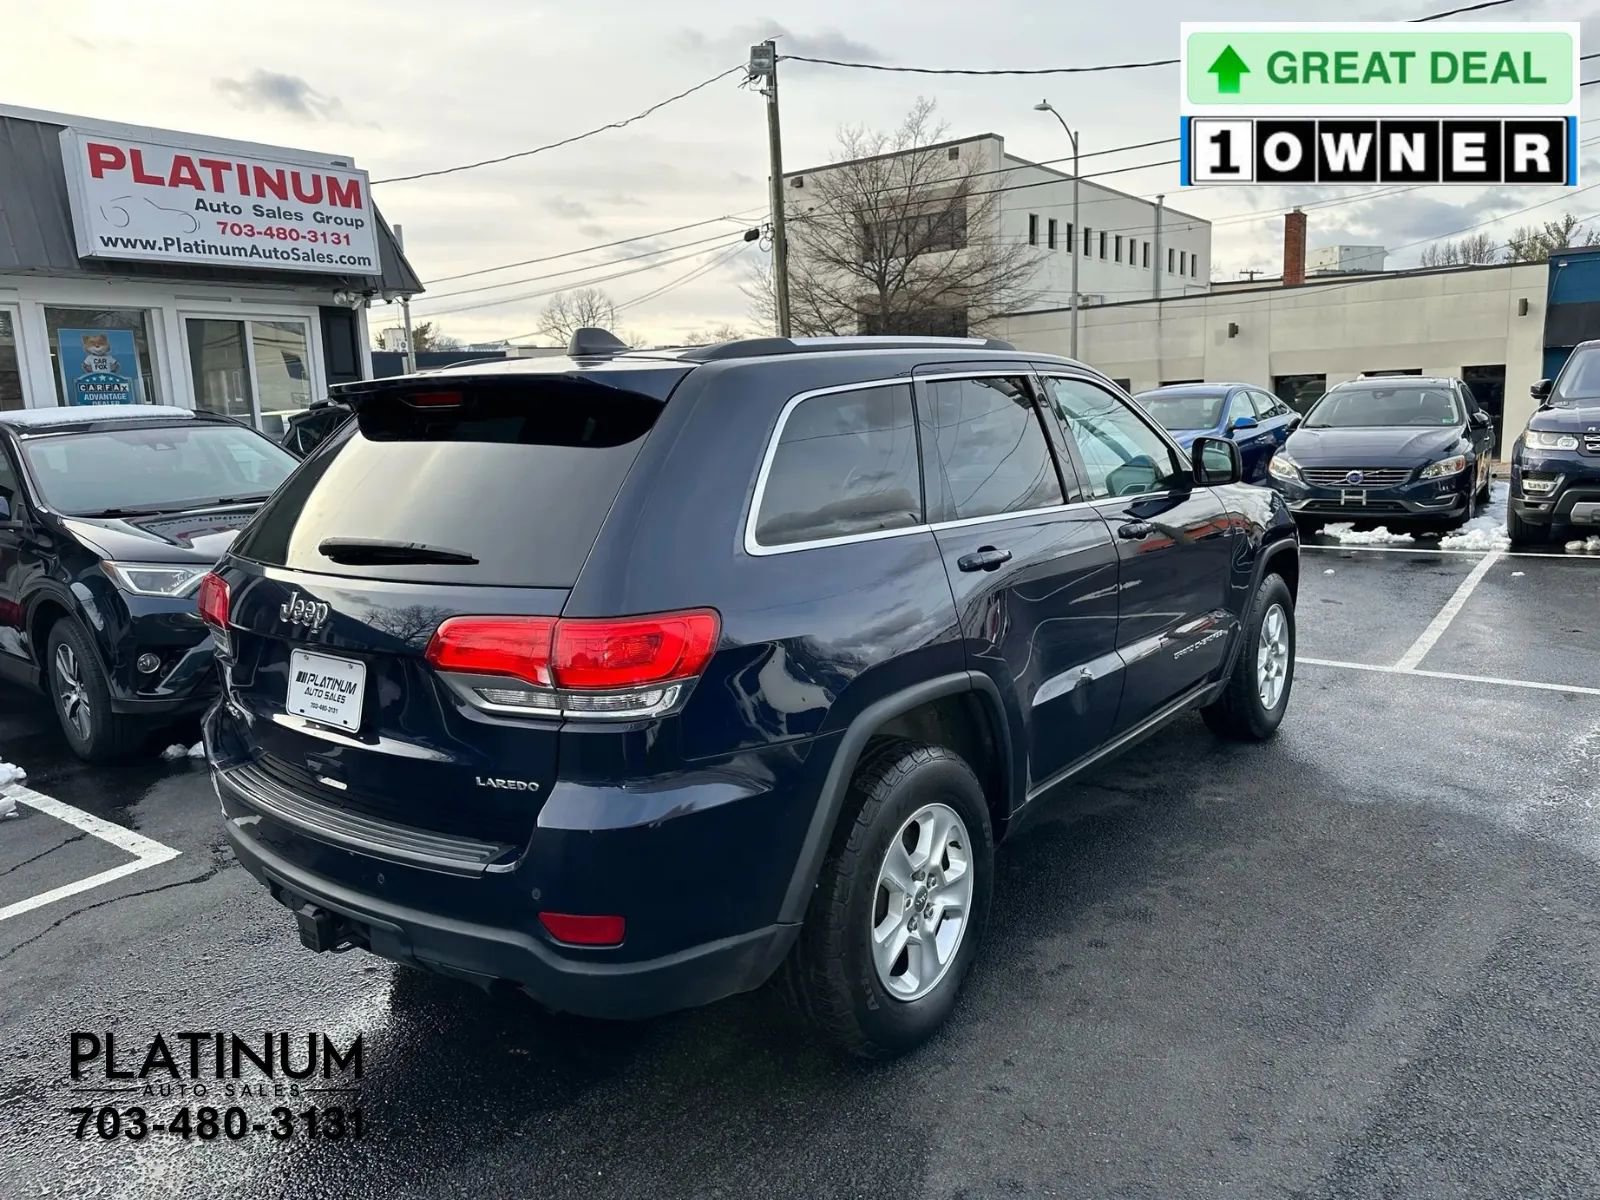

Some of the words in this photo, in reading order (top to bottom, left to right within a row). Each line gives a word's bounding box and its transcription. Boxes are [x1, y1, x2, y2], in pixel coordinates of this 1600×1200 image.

[86, 142, 363, 209] PLATINUM
[194, 198, 243, 216] Auto
[252, 204, 304, 222] Sales
[313, 211, 365, 230] Group
[216, 221, 351, 246] 703-480-3131
[100, 235, 372, 267] www.PlatinumAutoSales.com
[79, 384, 128, 392] CARFAX
[84, 393, 127, 401] ADVANTAGE
[280, 591, 329, 634] Jeep
[304, 686, 324, 698] AUTO
[323, 691, 346, 704] SALES
[306, 672, 358, 695] PLATINUM
[475, 776, 540, 792] LAREDO
